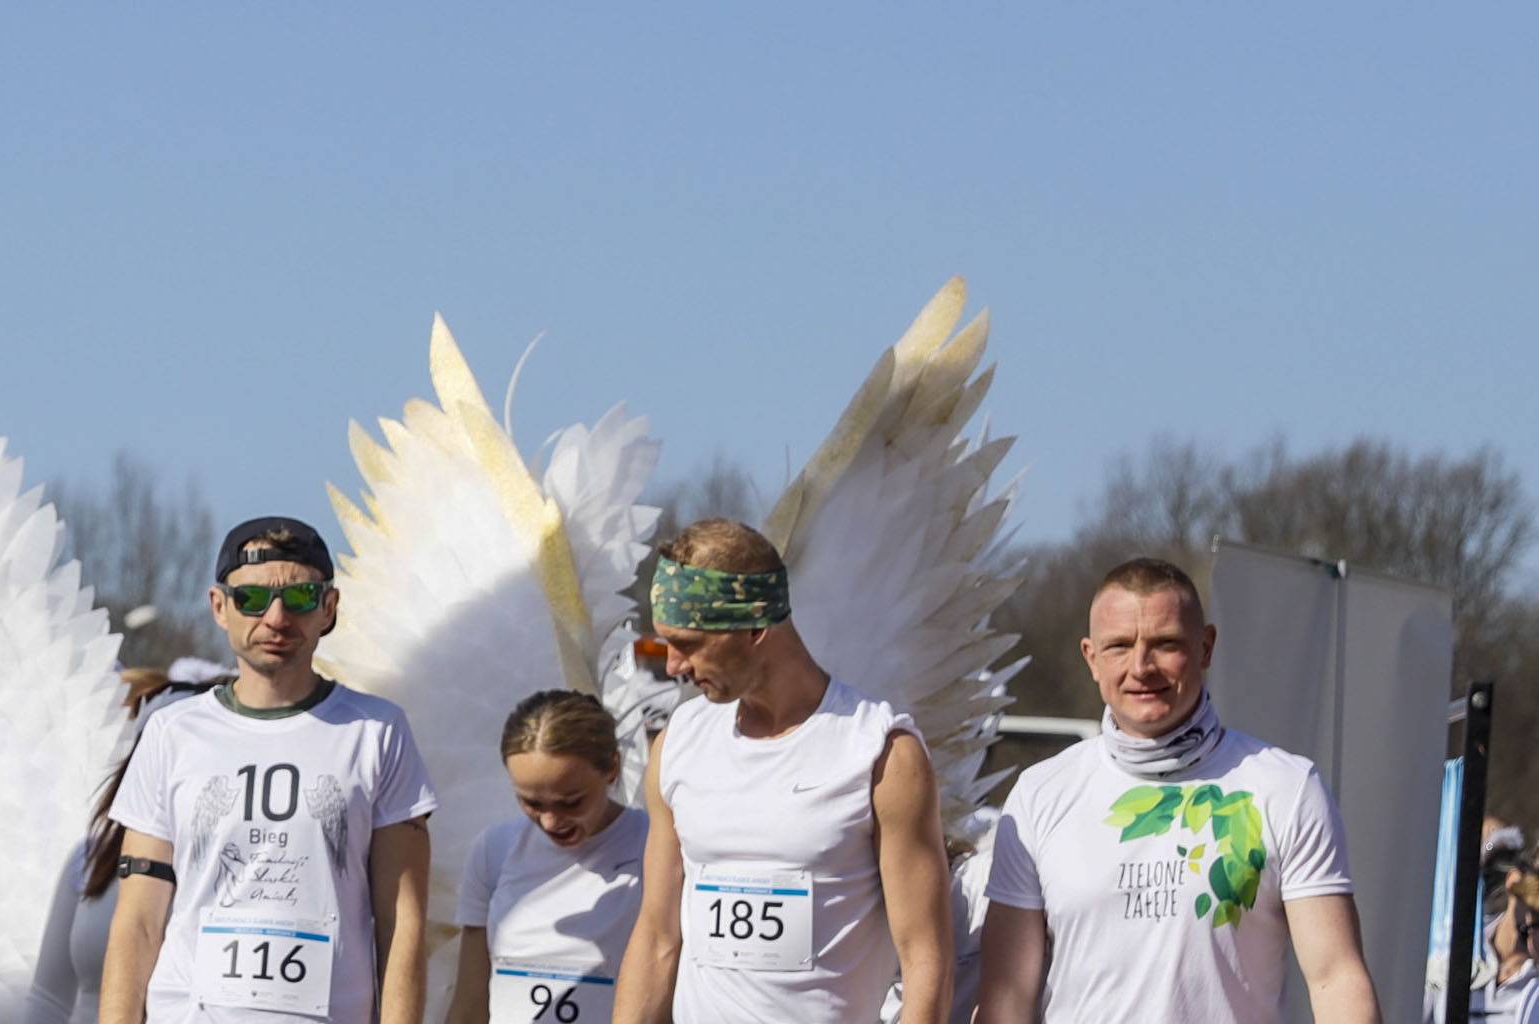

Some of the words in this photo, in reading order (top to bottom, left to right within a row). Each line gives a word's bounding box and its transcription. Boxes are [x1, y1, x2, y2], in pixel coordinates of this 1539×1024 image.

[237, 763, 300, 822] 10
[249, 828, 288, 848] Bieg
[1118, 860, 1185, 889] ZIELONE
[709, 898, 784, 941] 185
[222, 939, 306, 983] 116
[530, 984, 580, 1024] 96
